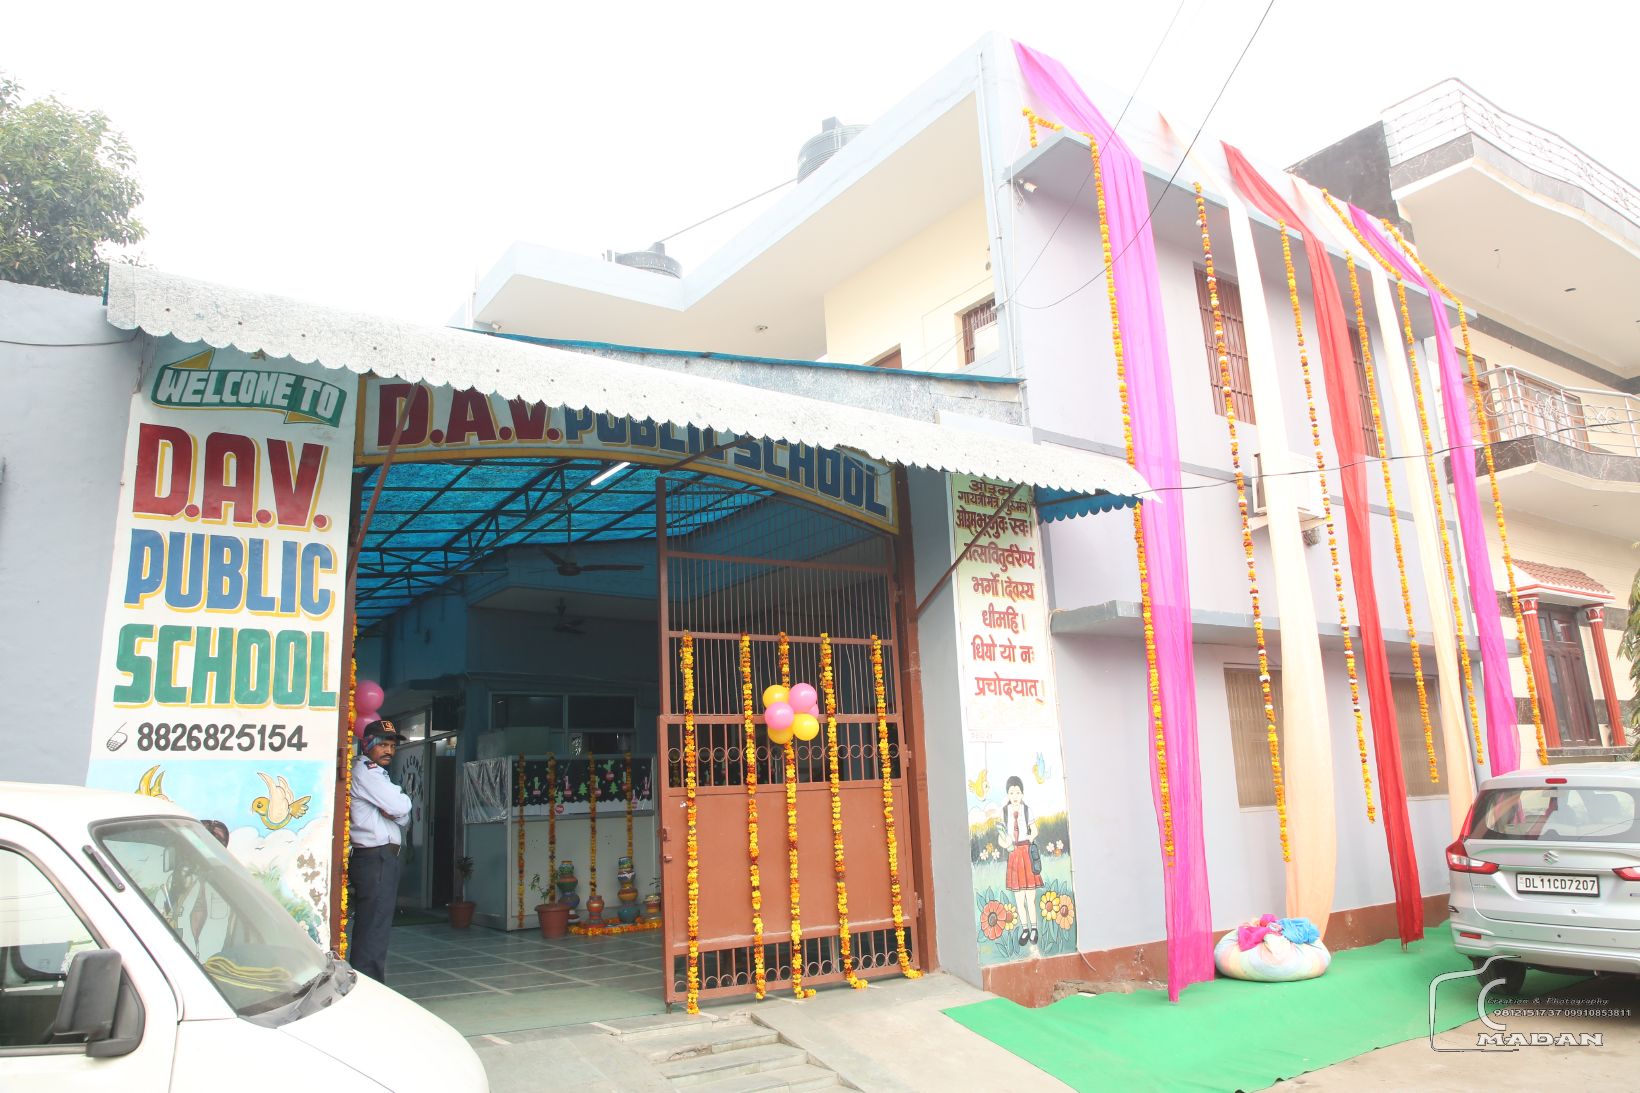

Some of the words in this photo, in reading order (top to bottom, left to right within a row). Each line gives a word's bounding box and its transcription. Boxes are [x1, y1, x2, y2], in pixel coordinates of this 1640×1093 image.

[156, 369, 293, 407] WELCOME
[300, 376, 341, 419] TO
[133, 423, 332, 532] D.A.V.
[377, 383, 562, 450] D.A.V.
[733, 430, 890, 519] SCHOOL
[124, 528, 338, 621] PUBLIC
[113, 623, 340, 711] SCHOOL
[999, 637, 1017, 663] यो
[137, 722, 308, 752] 8826825154
[1525, 877, 1596, 891] DL11CD7207
